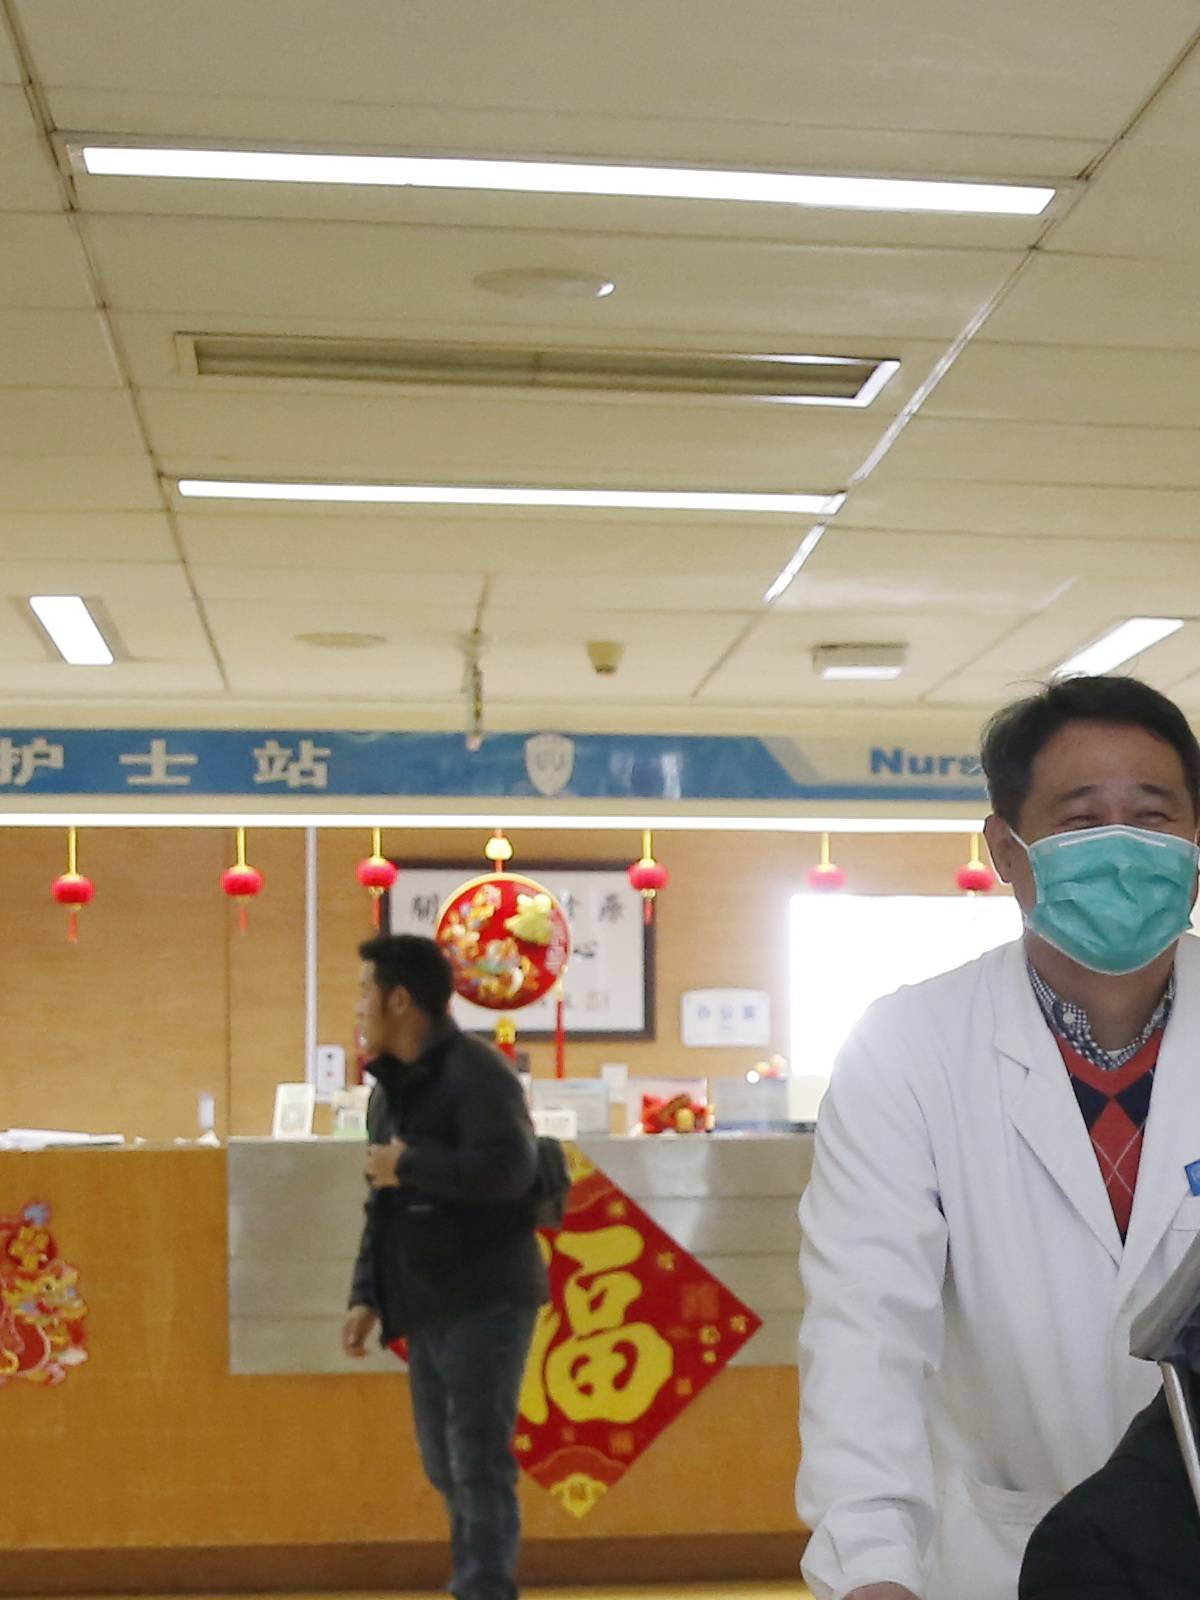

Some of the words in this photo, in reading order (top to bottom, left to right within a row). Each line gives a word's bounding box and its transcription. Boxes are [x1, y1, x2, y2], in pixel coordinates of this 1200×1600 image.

[0, 736, 332, 788] 护士站
[870, 747, 984, 776] Nurs
